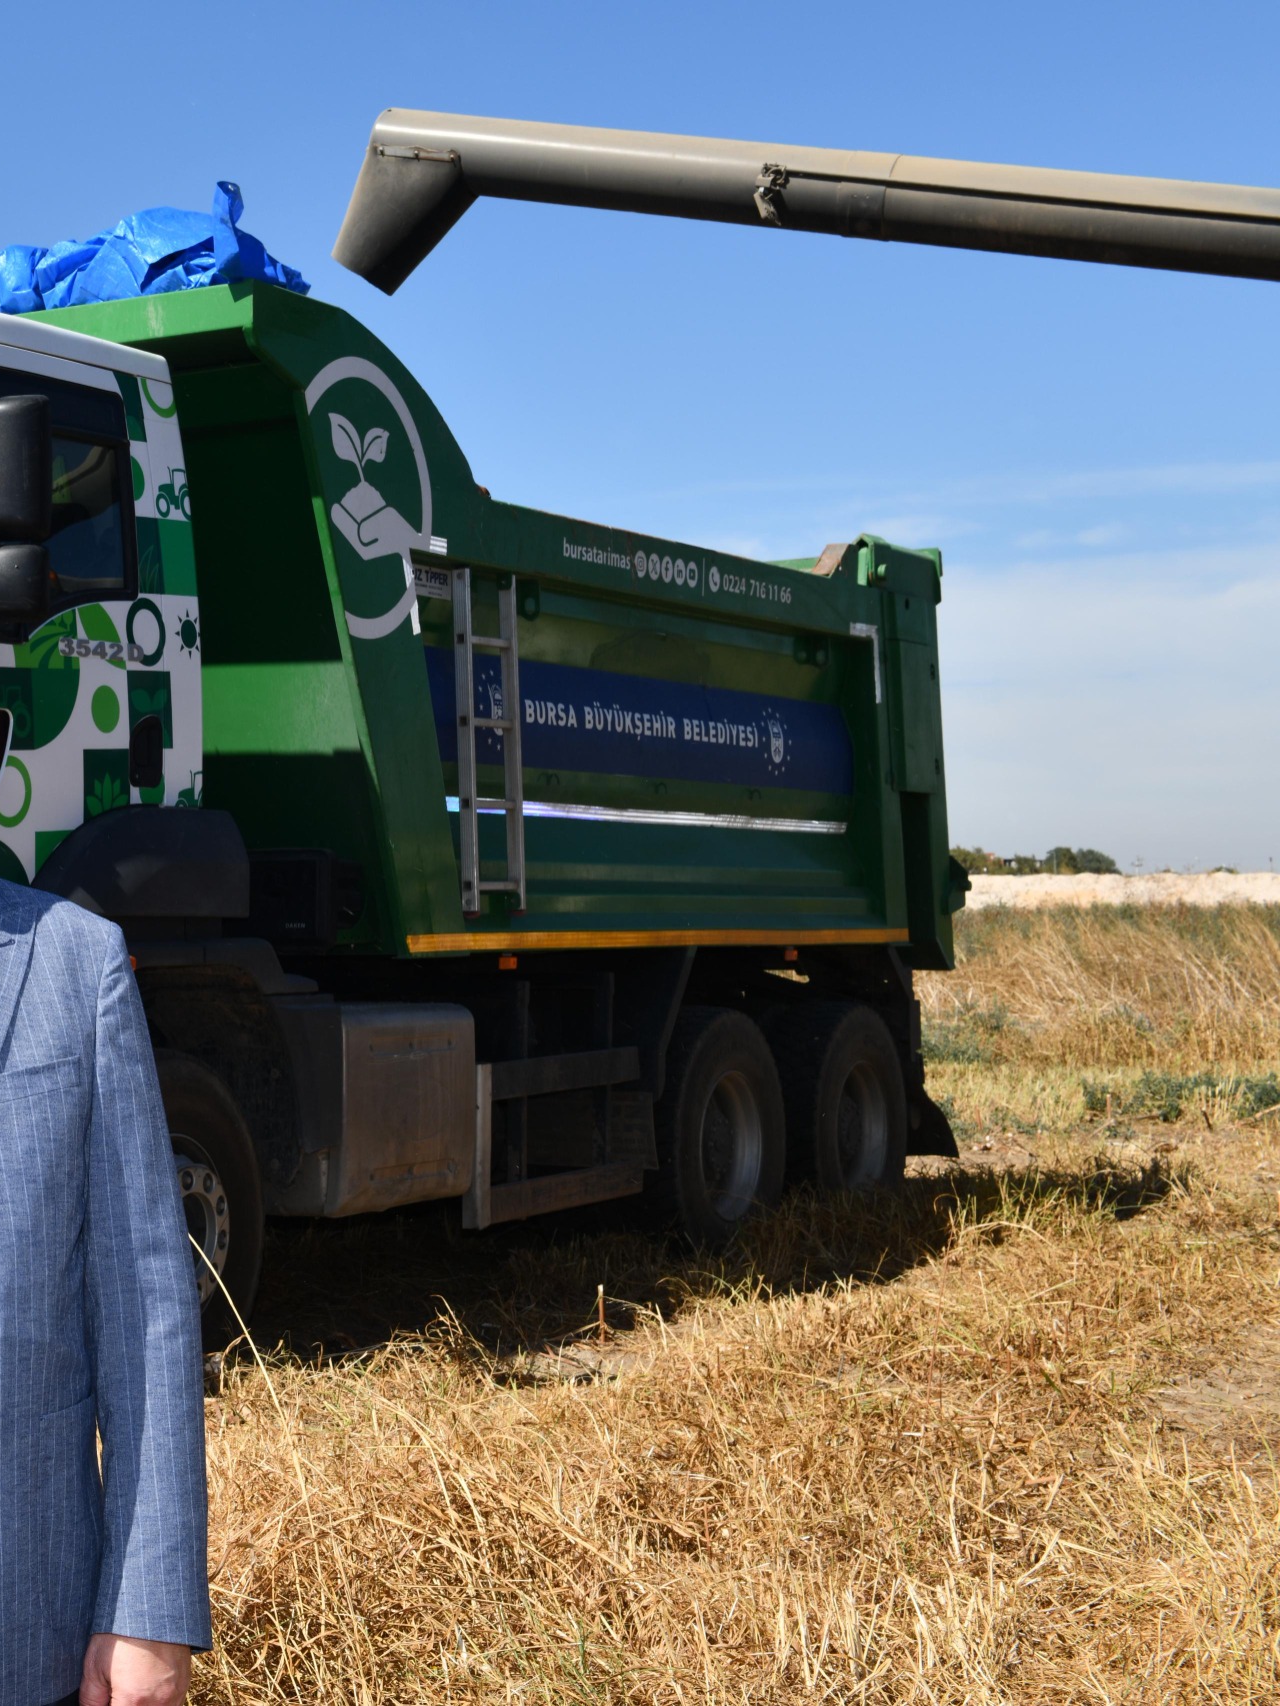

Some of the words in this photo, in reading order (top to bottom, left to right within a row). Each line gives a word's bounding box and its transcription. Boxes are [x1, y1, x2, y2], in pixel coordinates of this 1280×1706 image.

[563, 537, 631, 570] bursatarimas
[723, 574, 746, 594] 0224
[750, 579, 766, 599] 716
[780, 587, 792, 604] 66
[524, 699, 578, 728] BURSA
[584, 701, 677, 741] BÜYÜKŞEHİR
[683, 717, 759, 748] BELEDİYESİ
